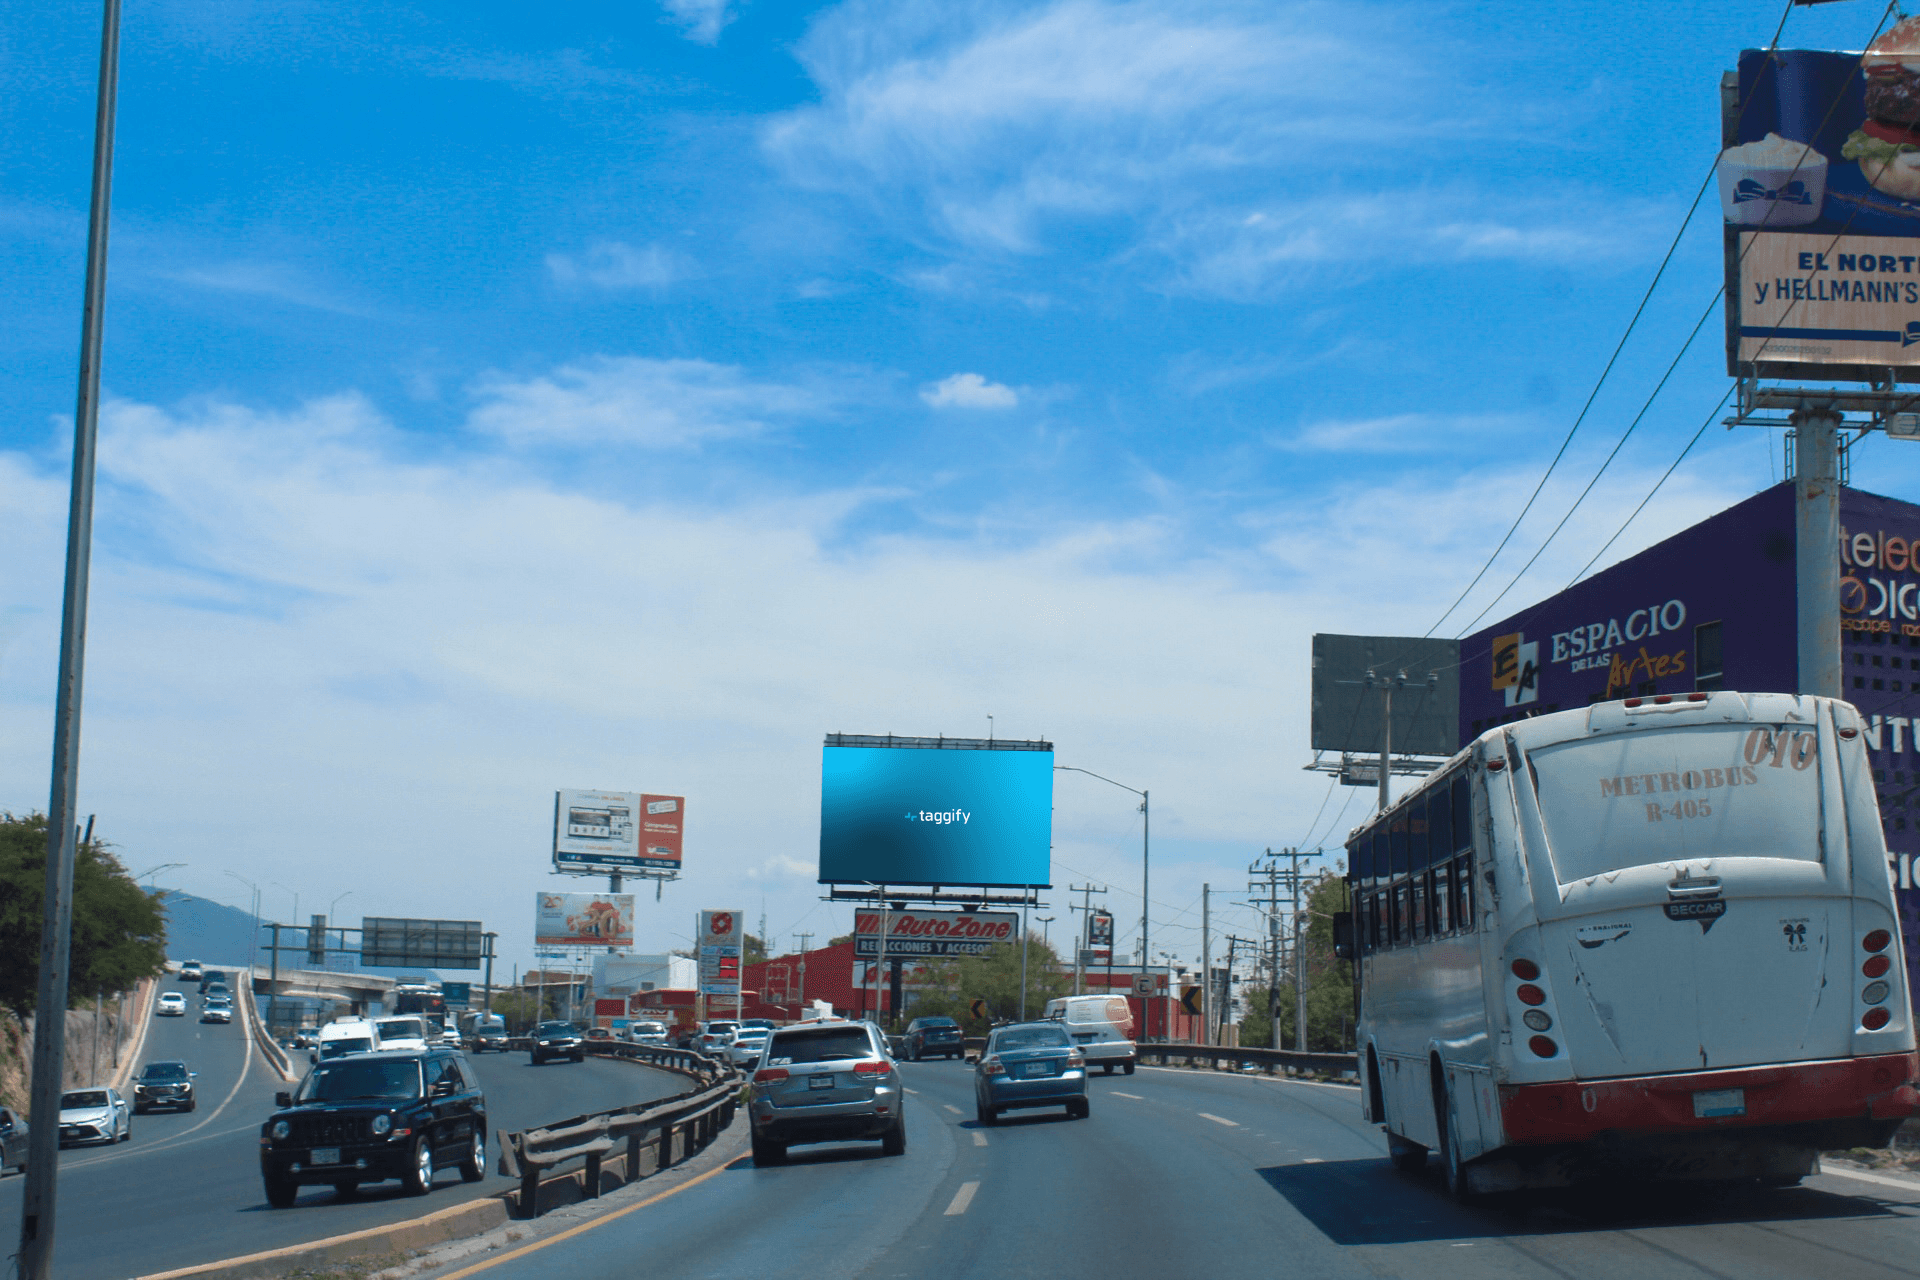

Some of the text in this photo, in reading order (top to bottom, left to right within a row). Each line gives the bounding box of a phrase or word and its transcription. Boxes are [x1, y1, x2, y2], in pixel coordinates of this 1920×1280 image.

[1798, 252, 1920, 273] EL NORT
[1754, 278, 1919, 305] y HELLMANN'S
[1551, 599, 1687, 663] ESPACIO
[1588, 653, 1611, 669] LAS
[1606, 646, 1688, 699] Artes
[1861, 714, 1920, 753] NT
[1743, 726, 1817, 773] 010
[1600, 765, 1759, 799] METROBUS
[919, 809, 971, 825] taggify
[1646, 799, 1712, 823] R-405
[1669, 903, 1724, 917] BECCAR
[892, 914, 1013, 939] AutoZone
[936, 942, 944, 953] Y
